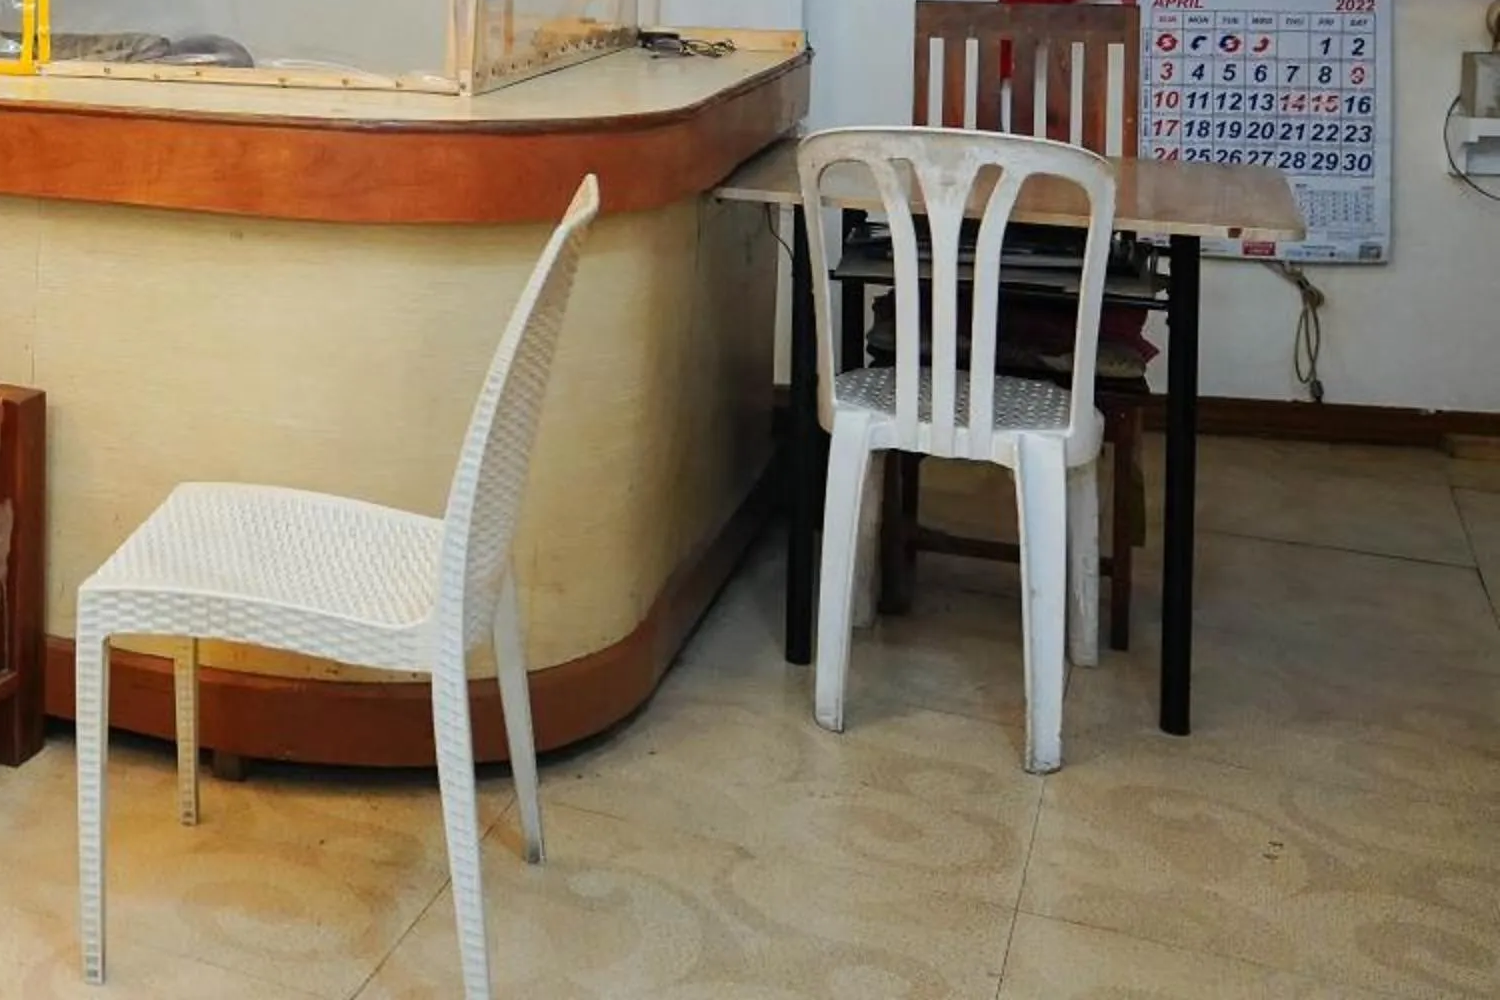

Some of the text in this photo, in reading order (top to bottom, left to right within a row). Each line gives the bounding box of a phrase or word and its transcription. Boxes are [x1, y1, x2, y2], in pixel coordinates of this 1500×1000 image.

[1320, 37, 1365, 56] 1 2
[1160, 63, 1365, 84] 3 4 5 6 7 8 9
[1154, 91, 1371, 114] 10 11 12 13 14 15 16
[1154, 119, 1373, 143] 17 18 19 20 21 22 23
[1154, 147, 1372, 171] 24 25 26 27 28 29 30
